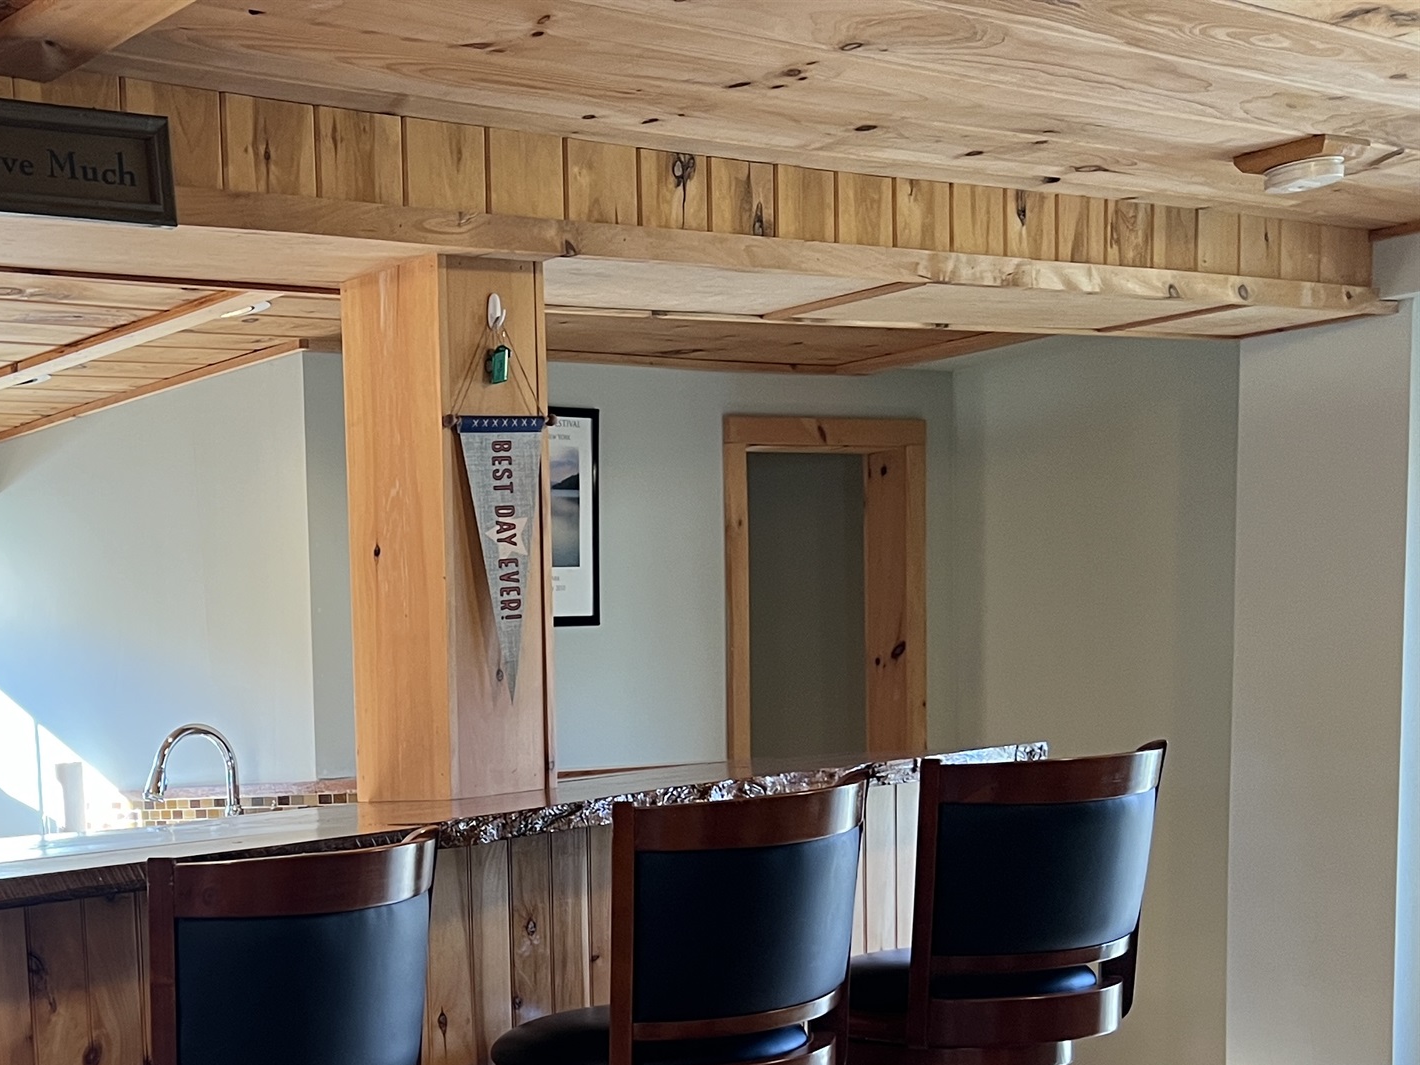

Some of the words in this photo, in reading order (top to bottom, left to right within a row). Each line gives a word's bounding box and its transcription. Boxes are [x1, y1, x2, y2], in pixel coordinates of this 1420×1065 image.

[47, 149, 138, 188] Much
[492, 440, 514, 494] BEST
[494, 505, 518, 546] DAY
[498, 557, 523, 620] EVER!
